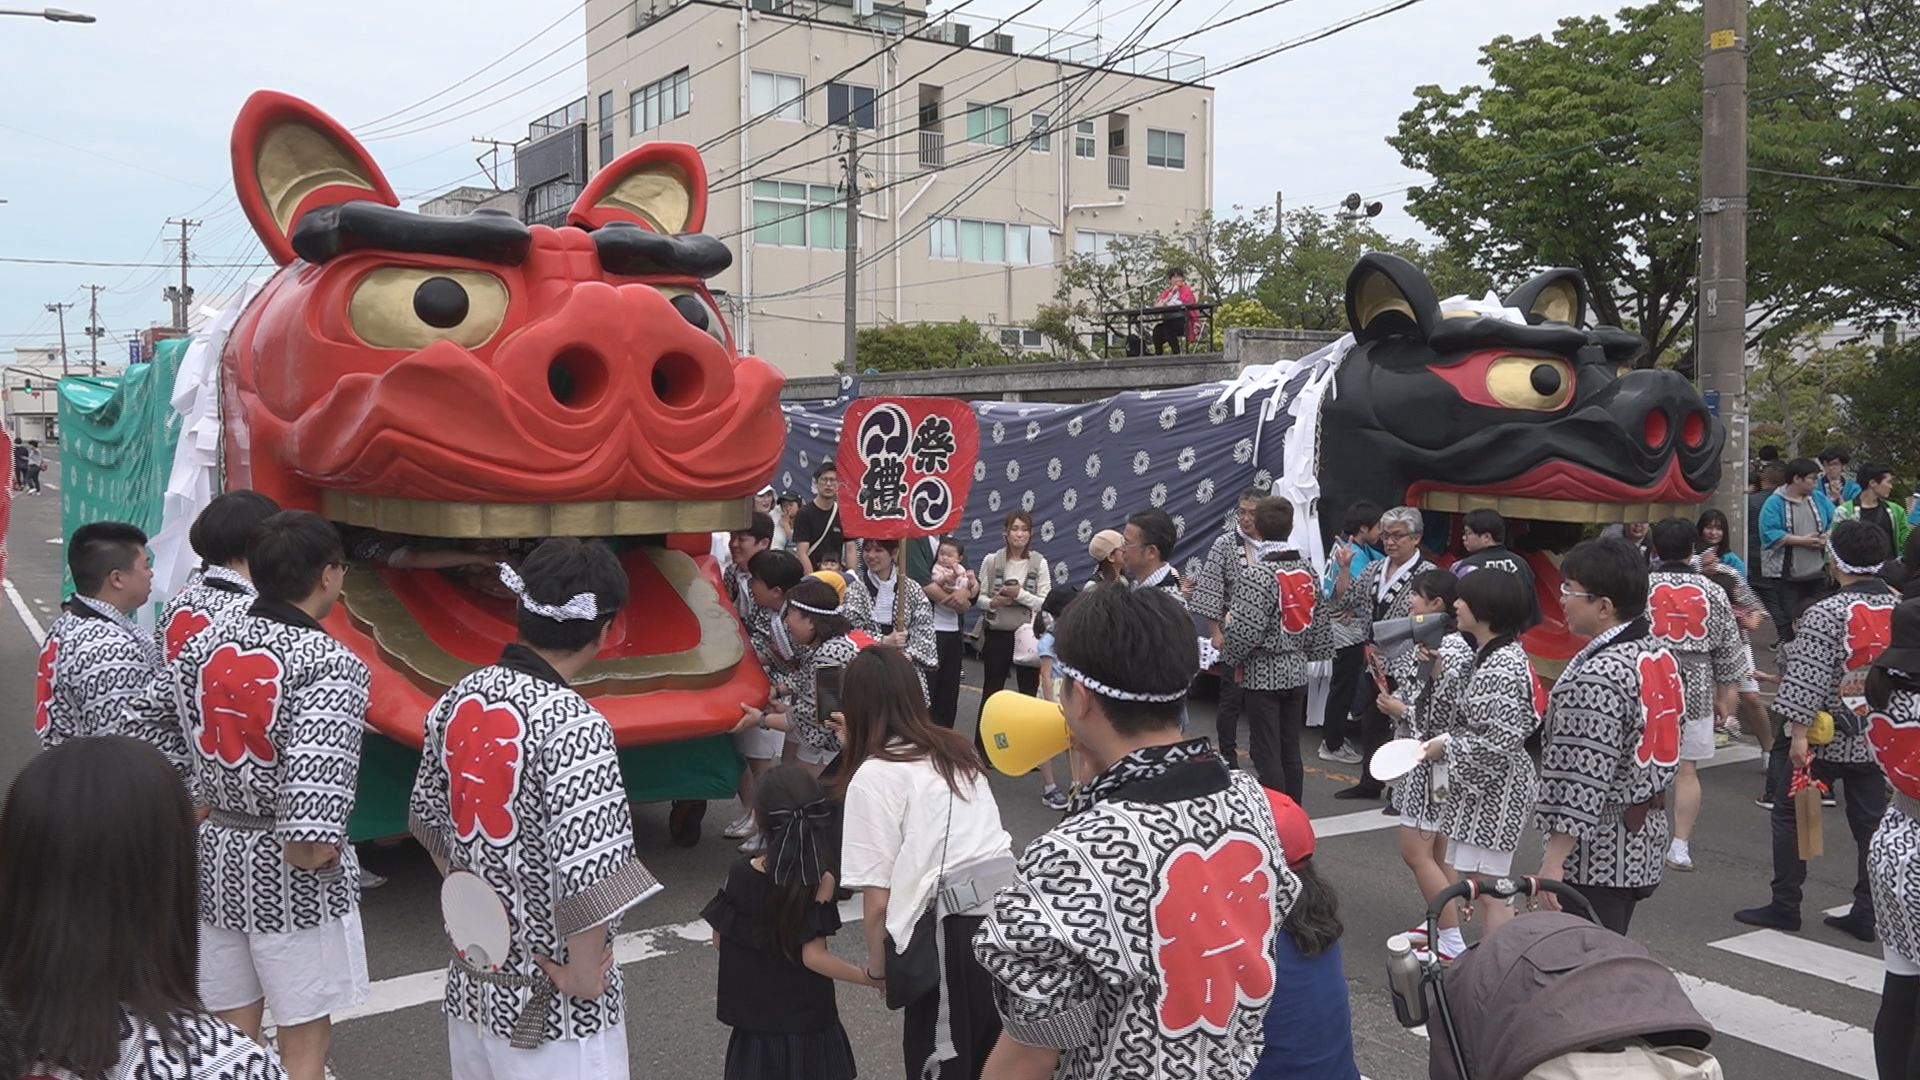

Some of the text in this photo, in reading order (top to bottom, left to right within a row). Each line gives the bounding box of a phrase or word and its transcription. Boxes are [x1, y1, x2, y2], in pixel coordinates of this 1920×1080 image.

[912, 415, 956, 474] 祭
[1649, 583, 1710, 641] 祭
[197, 643, 282, 767] 祭
[443, 696, 523, 842] 祭
[1153, 837, 1273, 1032] 祭
